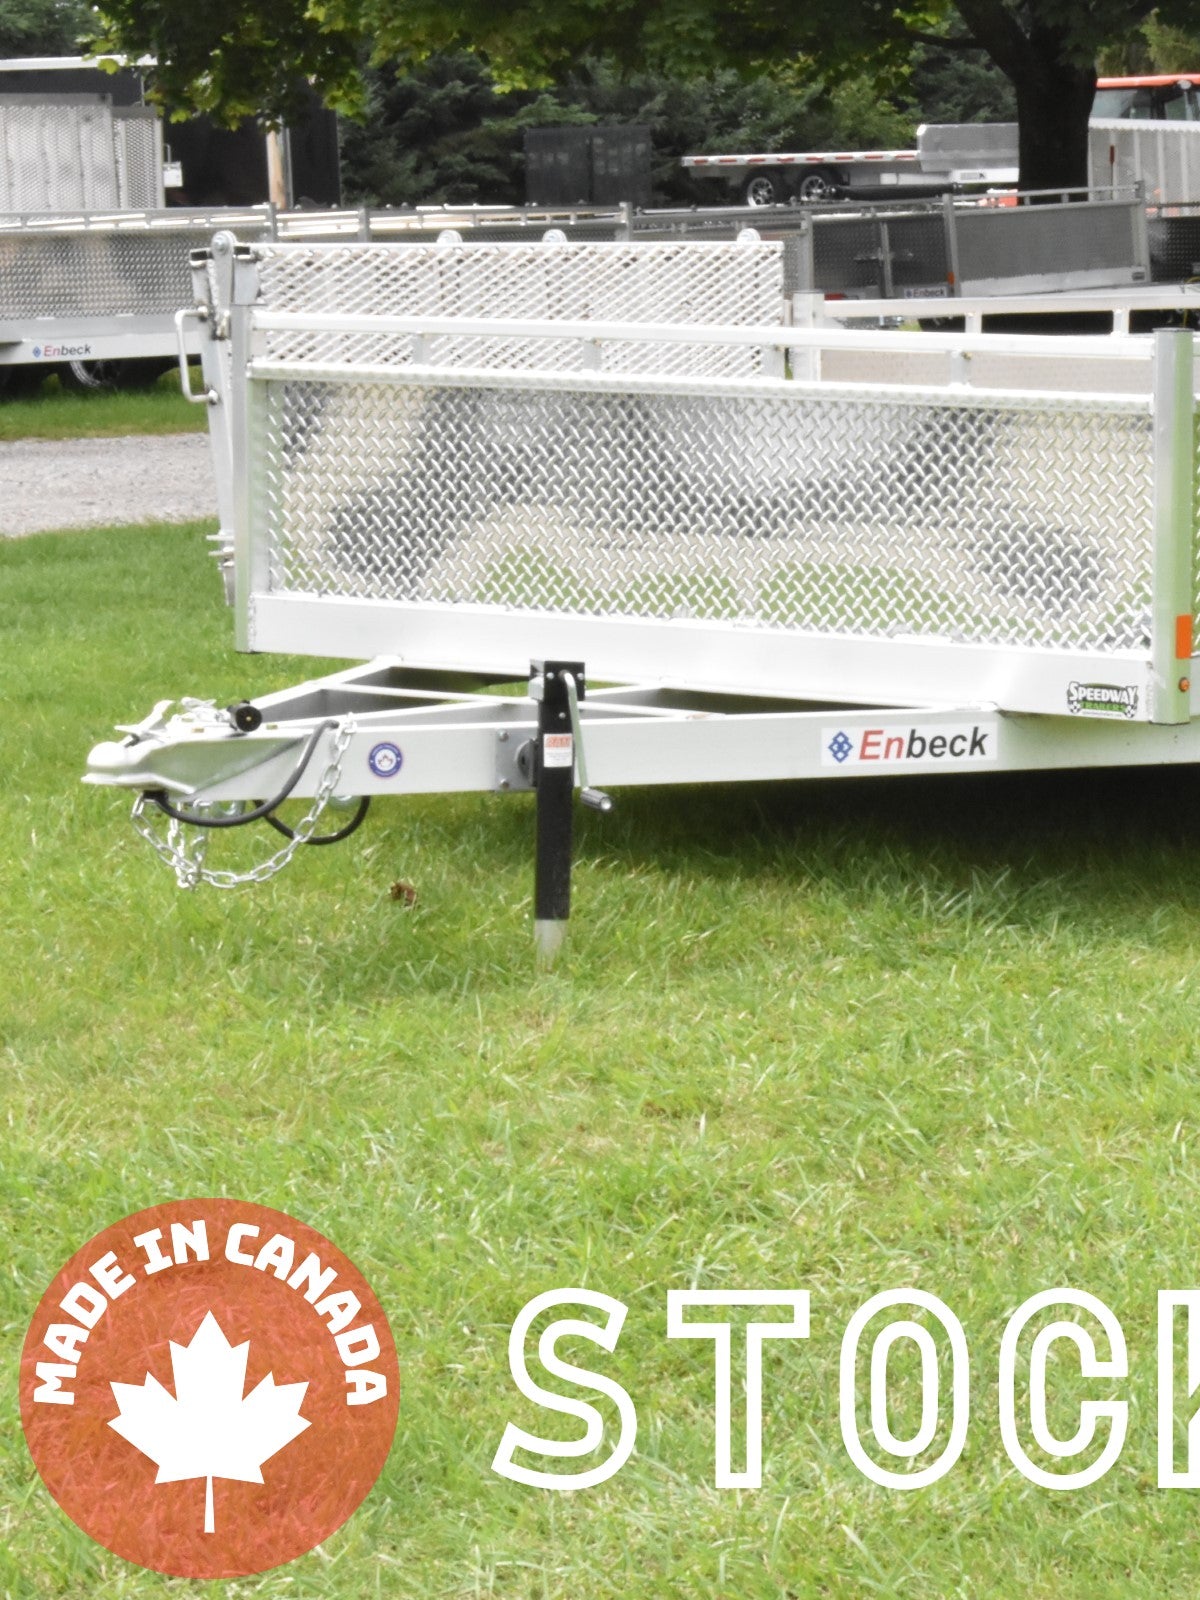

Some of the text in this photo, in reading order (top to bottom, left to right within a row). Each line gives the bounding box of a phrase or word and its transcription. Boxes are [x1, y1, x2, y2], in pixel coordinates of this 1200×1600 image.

[44, 344, 91, 357] Enbeck
[1067, 681, 1138, 706] SPEEDWAY
[859, 726, 989, 760] Enbeck
